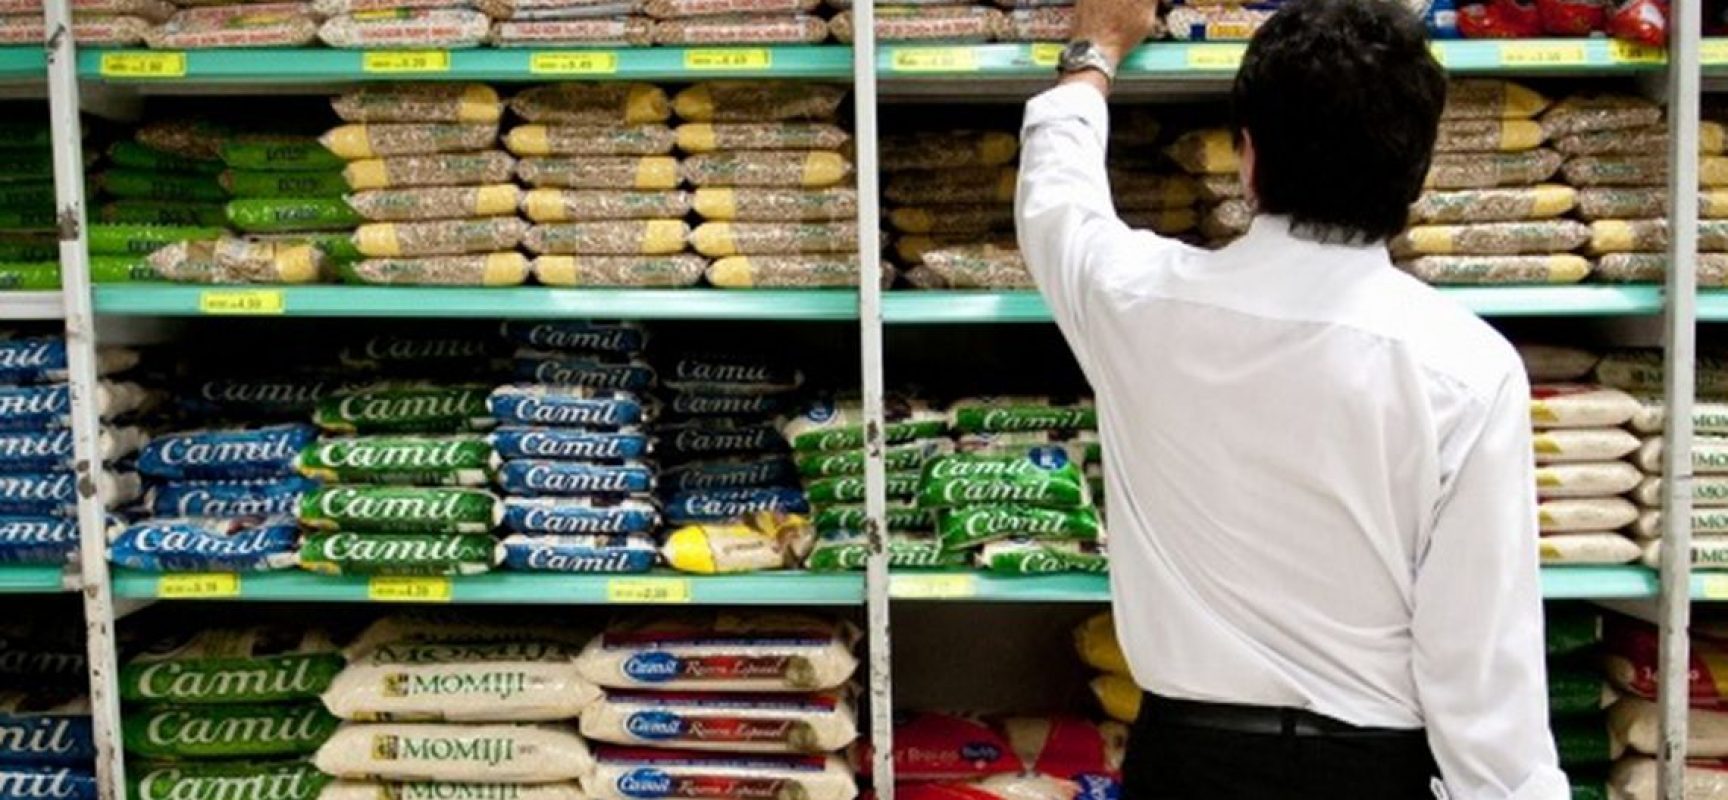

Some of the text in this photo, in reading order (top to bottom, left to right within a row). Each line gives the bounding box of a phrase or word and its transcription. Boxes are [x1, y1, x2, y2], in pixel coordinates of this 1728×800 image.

[531, 325, 624, 349] Camil
[537, 361, 632, 388] Camil
[340, 391, 474, 420] Camil
[516, 398, 619, 424] Camil
[983, 409, 1084, 429] Camil
[160, 433, 296, 465] Camil
[320, 441, 468, 468] Camil
[520, 432, 619, 456] Camil
[526, 466, 627, 491] Camil
[931, 455, 1029, 479] Camil
[321, 487, 464, 518] Camil
[944, 478, 1054, 501] Camil
[525, 508, 625, 532] Camil
[967, 510, 1068, 536] Camil
[135, 527, 271, 555] Camil
[323, 532, 467, 560] Camil
[529, 547, 631, 572] Camil
[138, 658, 316, 698] Camil
[413, 671, 526, 700] MOMIJI
[148, 709, 322, 746] Camil
[629, 716, 682, 734] Camil
[404, 737, 514, 767] MOMIJI
[138, 766, 318, 800] Camil
